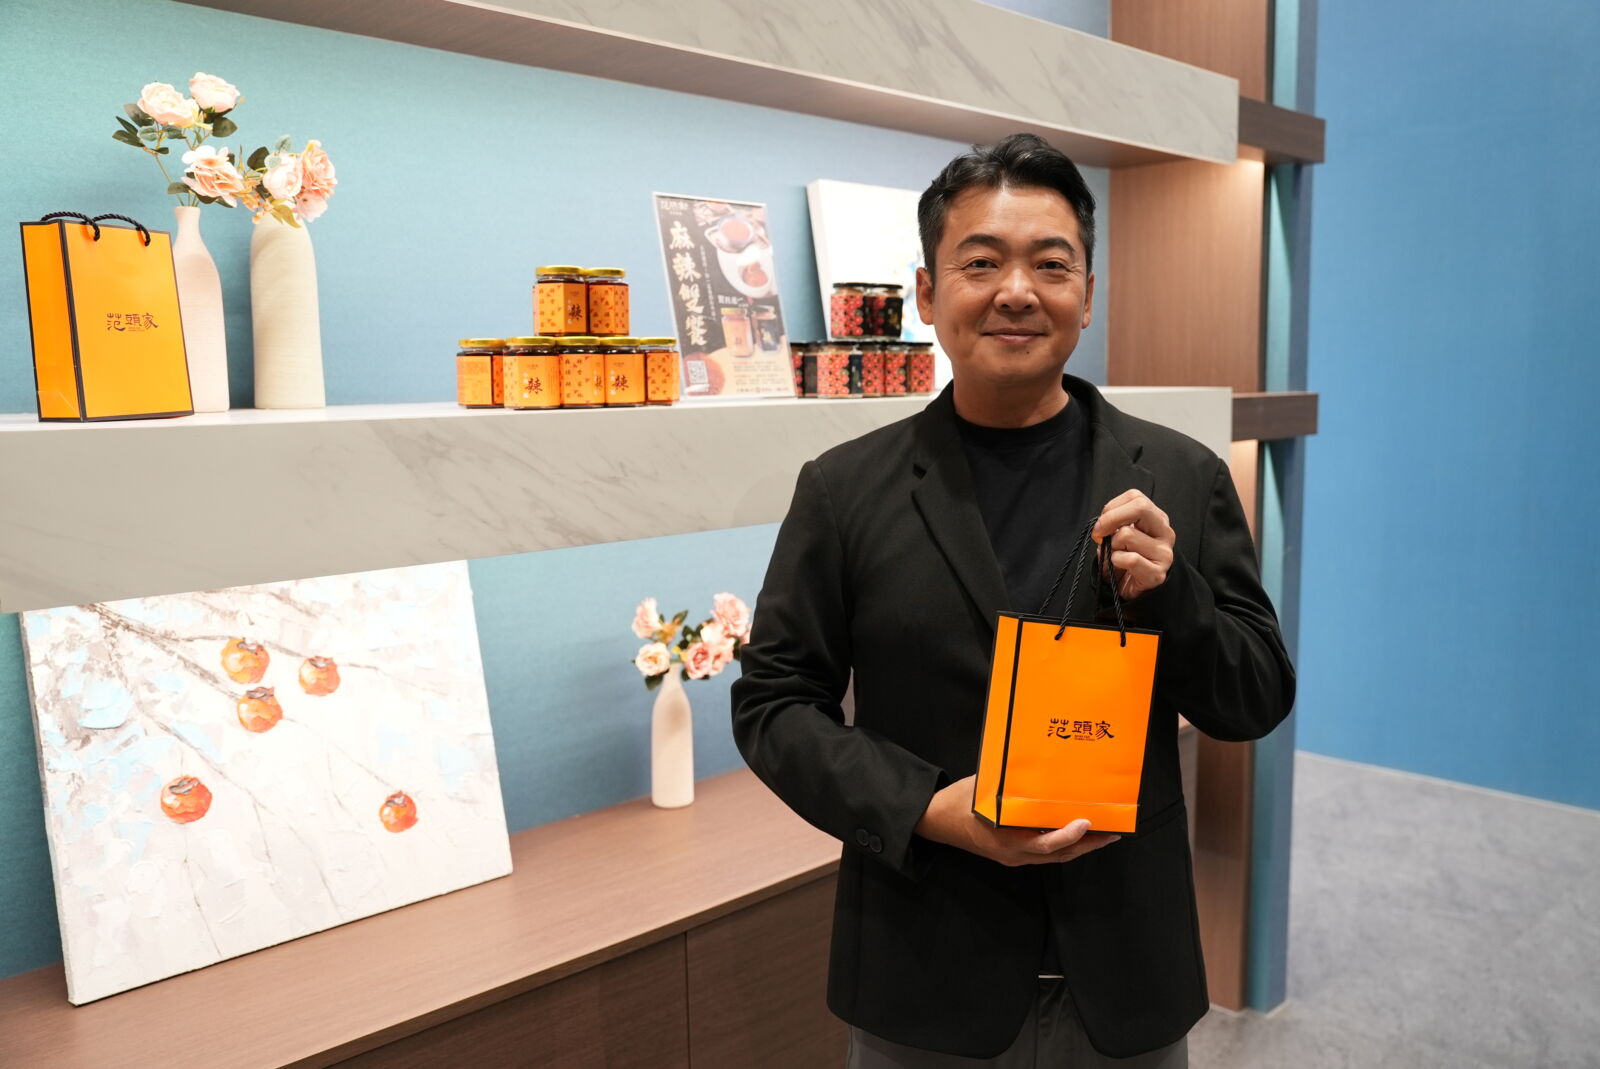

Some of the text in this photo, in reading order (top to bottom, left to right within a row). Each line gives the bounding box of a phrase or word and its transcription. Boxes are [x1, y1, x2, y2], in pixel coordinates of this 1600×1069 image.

[106, 312, 158, 332] 范頭家
[1047, 718, 1115, 740] 范頭家
